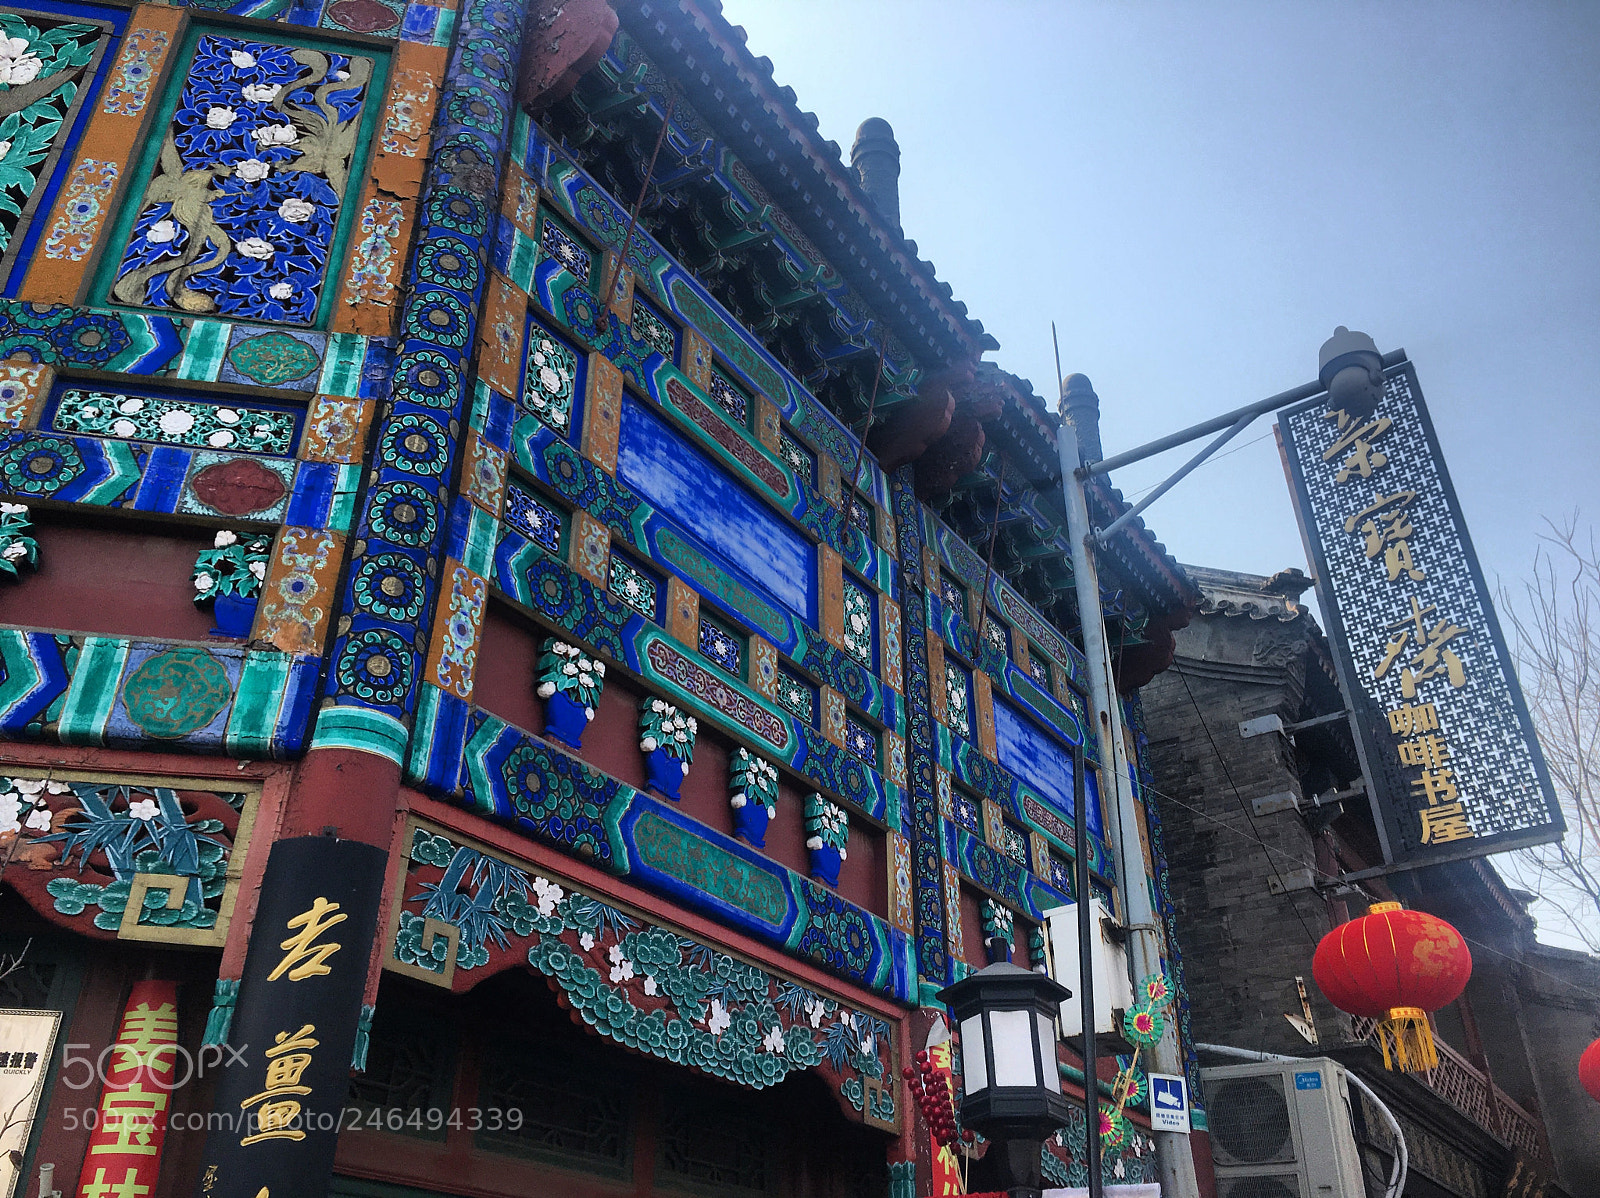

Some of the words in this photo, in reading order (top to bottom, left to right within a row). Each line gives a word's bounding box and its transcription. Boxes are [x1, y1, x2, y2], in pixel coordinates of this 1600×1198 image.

[1387, 702, 1475, 846] 咖啡书屋
[1162, 1119, 1180, 1127] Video
